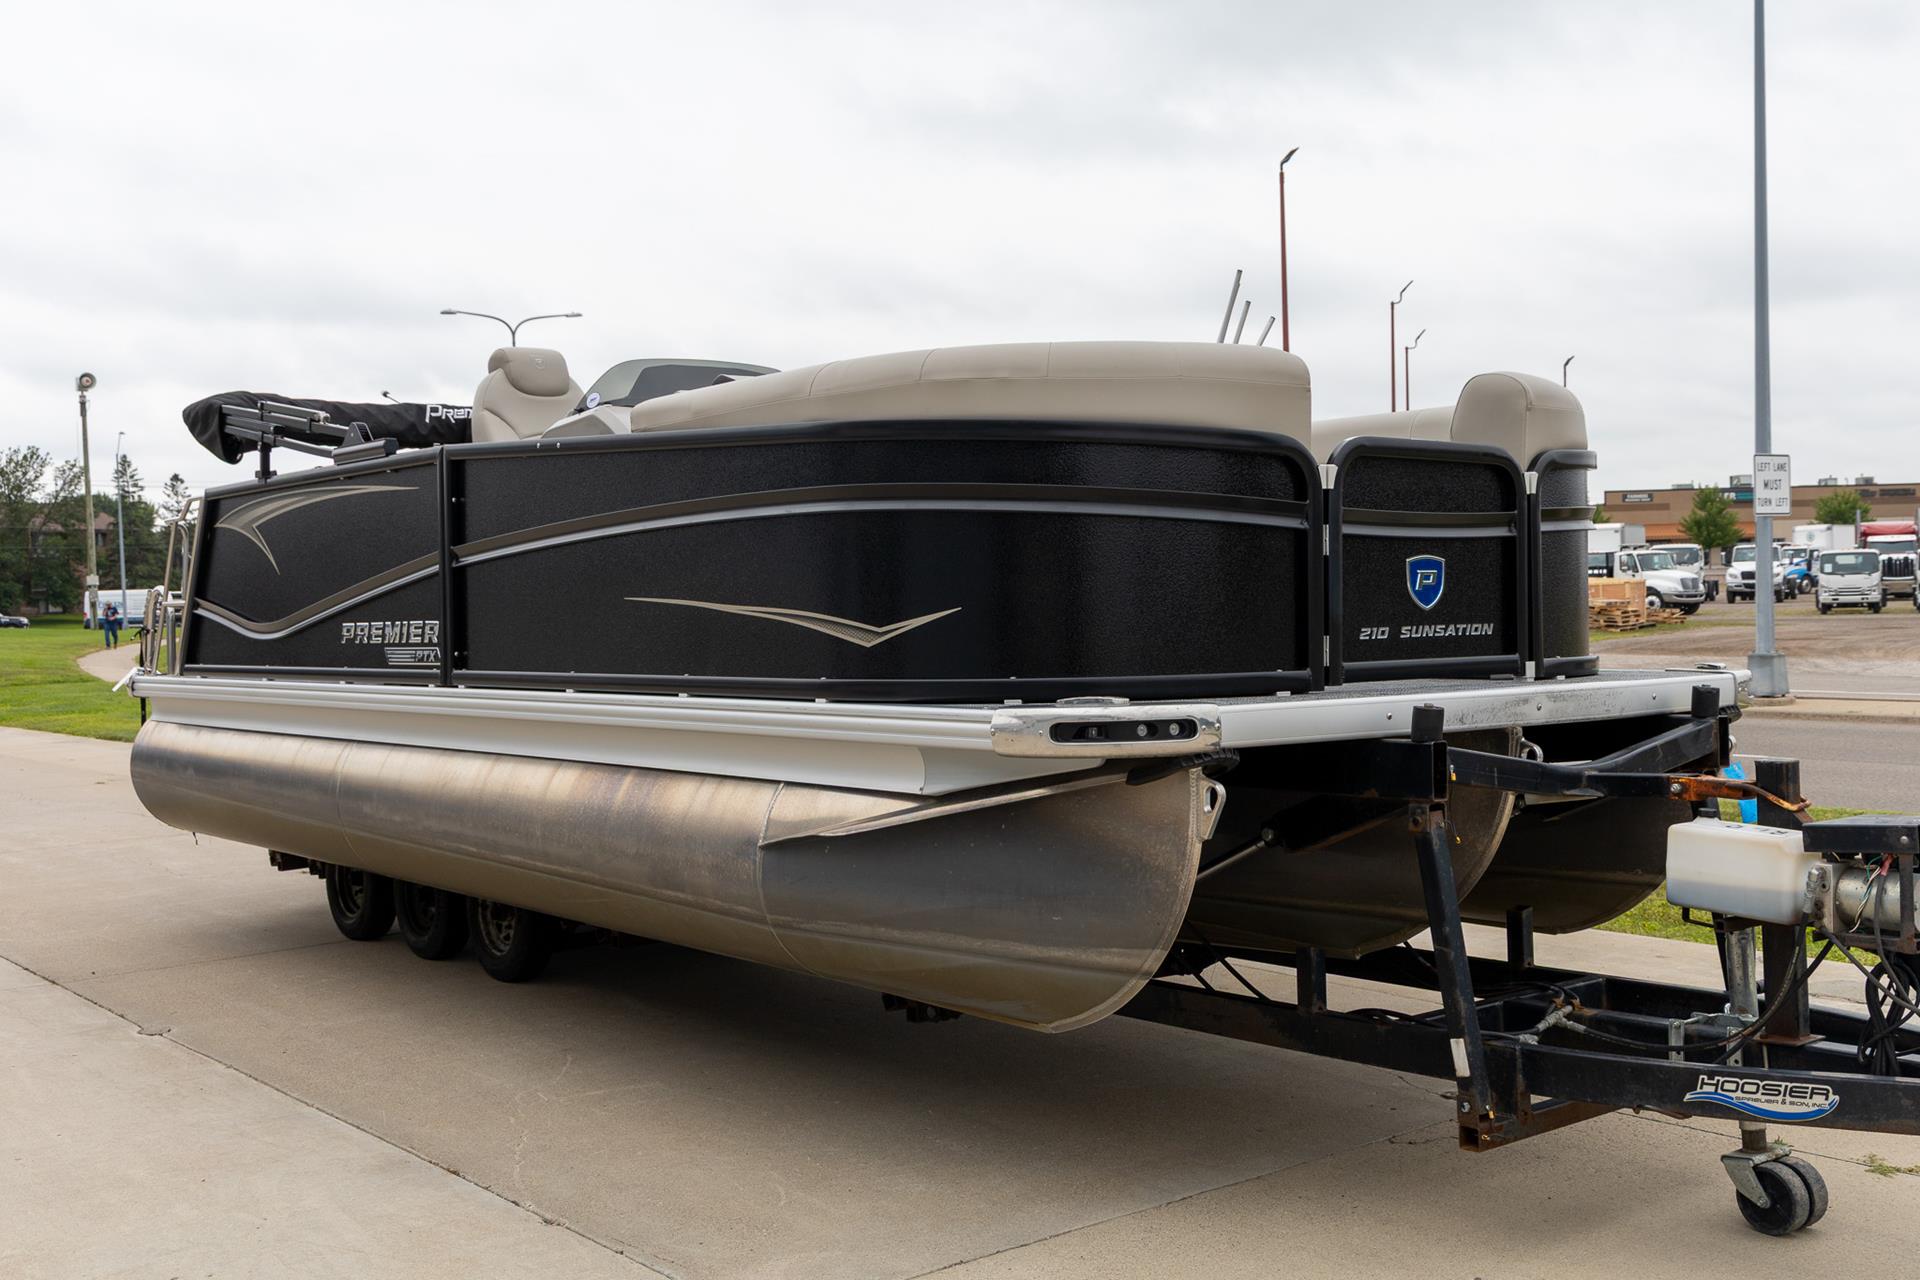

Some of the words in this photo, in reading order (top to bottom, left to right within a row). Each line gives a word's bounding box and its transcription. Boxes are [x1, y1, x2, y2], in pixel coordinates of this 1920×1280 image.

[1757, 462, 1771, 472] LEFT
[1773, 462, 1787, 472] LANE
[1763, 479, 1782, 490] MUST
[1758, 497, 1772, 507] TURN
[1775, 497, 1788, 507] LEFT
[341, 620, 440, 644] PREMIER
[1359, 626, 1390, 640] 210
[1400, 623, 1494, 639] SUNSATION
[415, 650, 437, 662] PTX
[1699, 1076, 1831, 1101] HOOSIER
[1780, 1098, 1787, 1106] &
